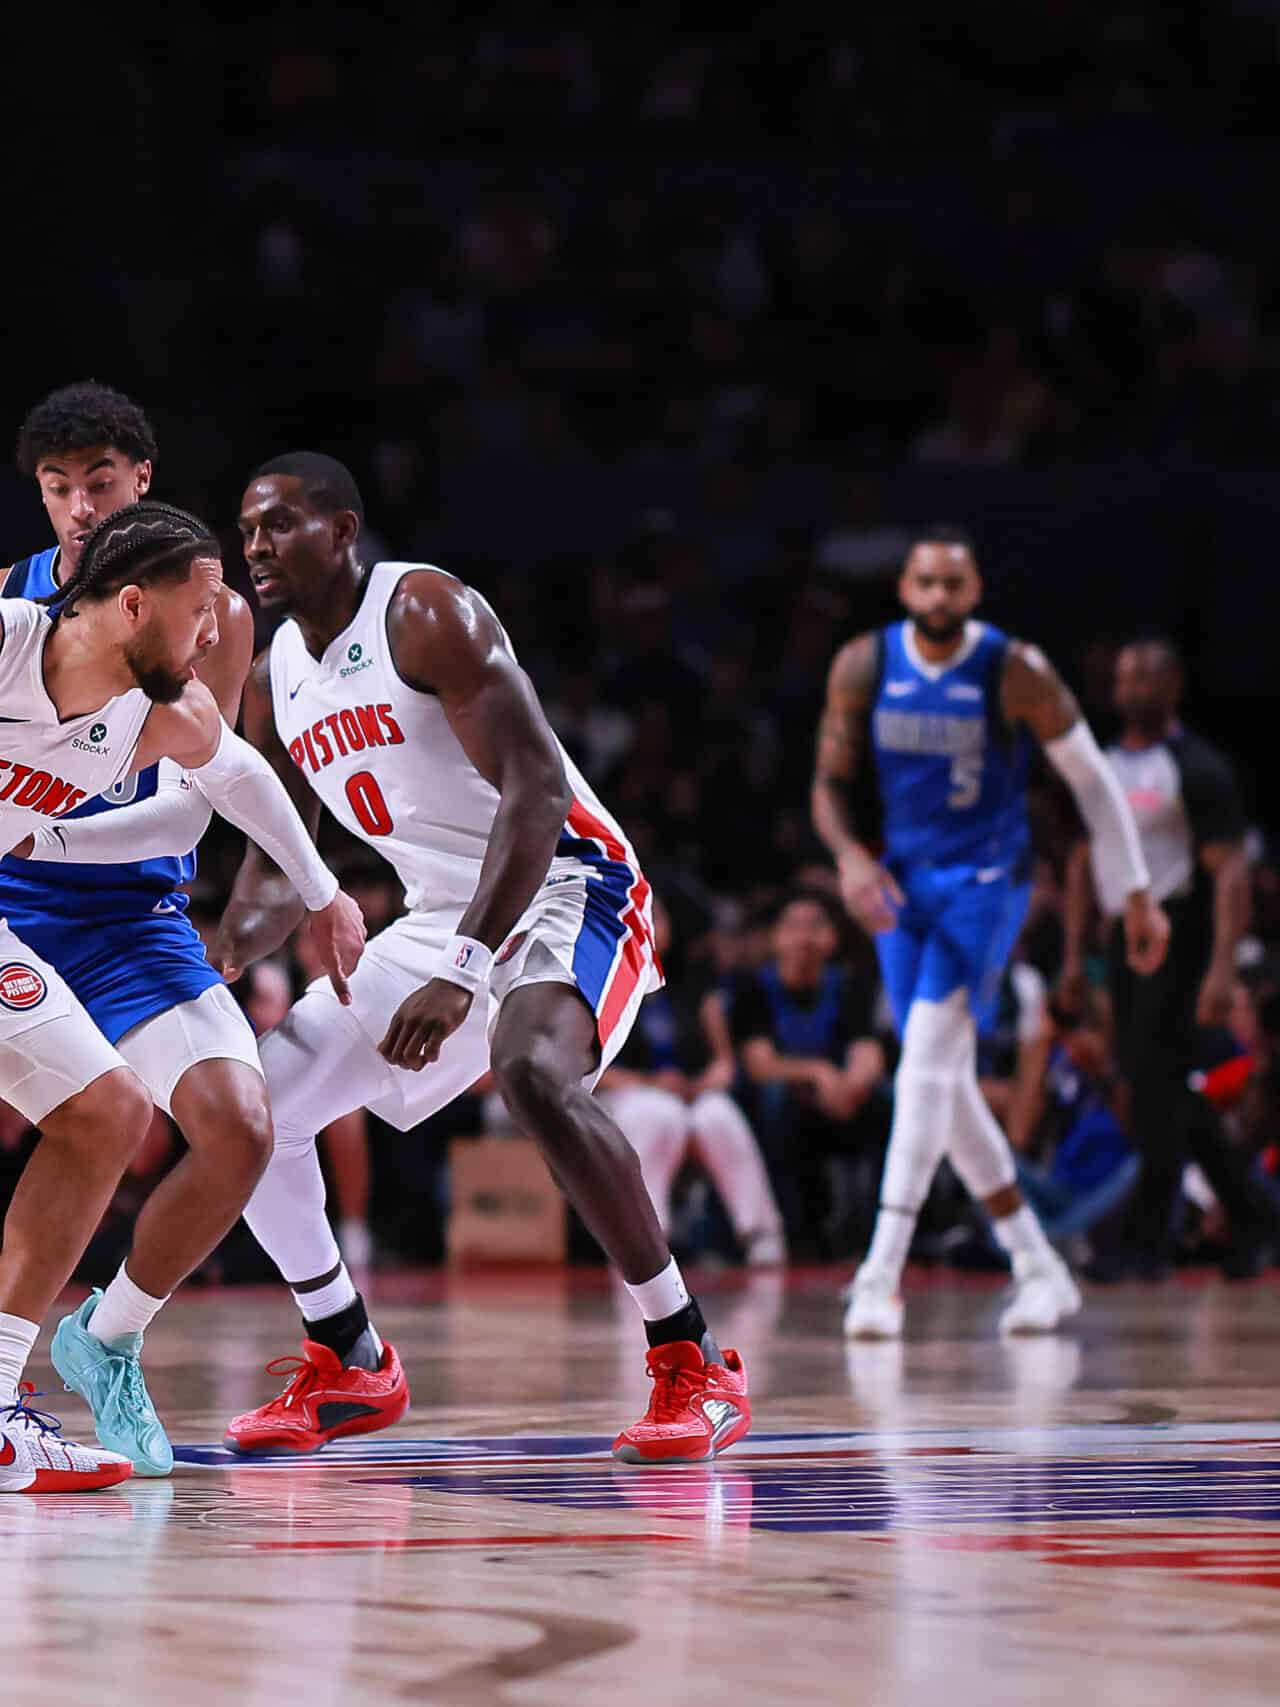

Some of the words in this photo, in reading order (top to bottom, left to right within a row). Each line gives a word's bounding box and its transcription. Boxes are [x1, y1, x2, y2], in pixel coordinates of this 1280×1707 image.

[71, 738, 111, 756] StockX
[288, 704, 406, 773] PISTONS
[345, 771, 394, 836] 0
